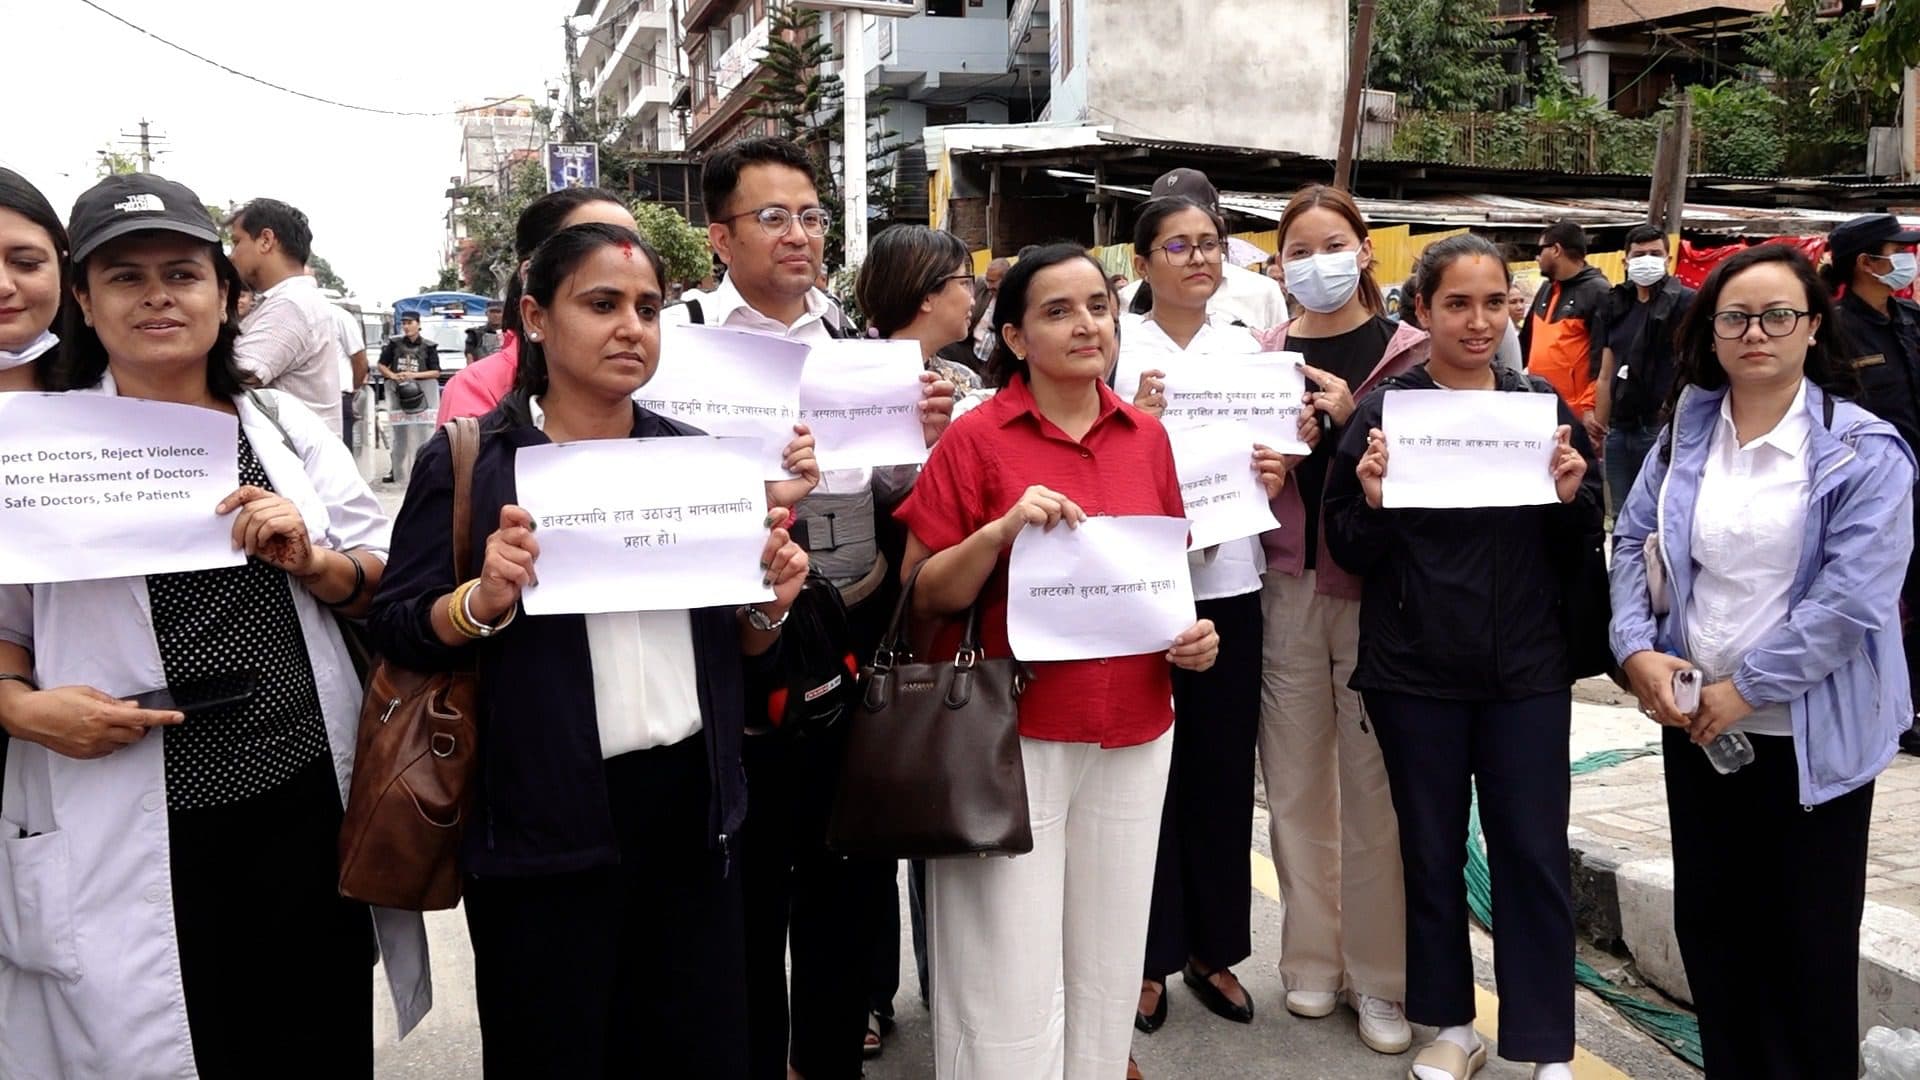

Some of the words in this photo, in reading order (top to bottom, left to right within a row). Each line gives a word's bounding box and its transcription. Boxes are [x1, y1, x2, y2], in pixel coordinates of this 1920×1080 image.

[0, 453, 33, 465] pect
[38, 451, 97, 461] Doctors,
[101, 448, 143, 461] Reject
[147, 445, 209, 458] Violence.
[5, 474, 45, 486] More
[49, 471, 132, 483] Harassment
[136, 468, 151, 480] of
[154, 468, 209, 479] Doctors.
[5, 496, 36, 509] Safe
[41, 495, 100, 507] Doctors,
[104, 491, 133, 503] Safe
[137, 489, 191, 501] Patients
[540, 508, 607, 527] डाक्टरमाथि
[613, 510, 635, 522] हात
[640, 506, 683, 522] उठाउनु
[688, 498, 753, 516] मानवतामाथि
[623, 535, 652, 548] प्रहार
[1030, 583, 1075, 597] डाक्टरको
[1111, 579, 1147, 595] जनताको
